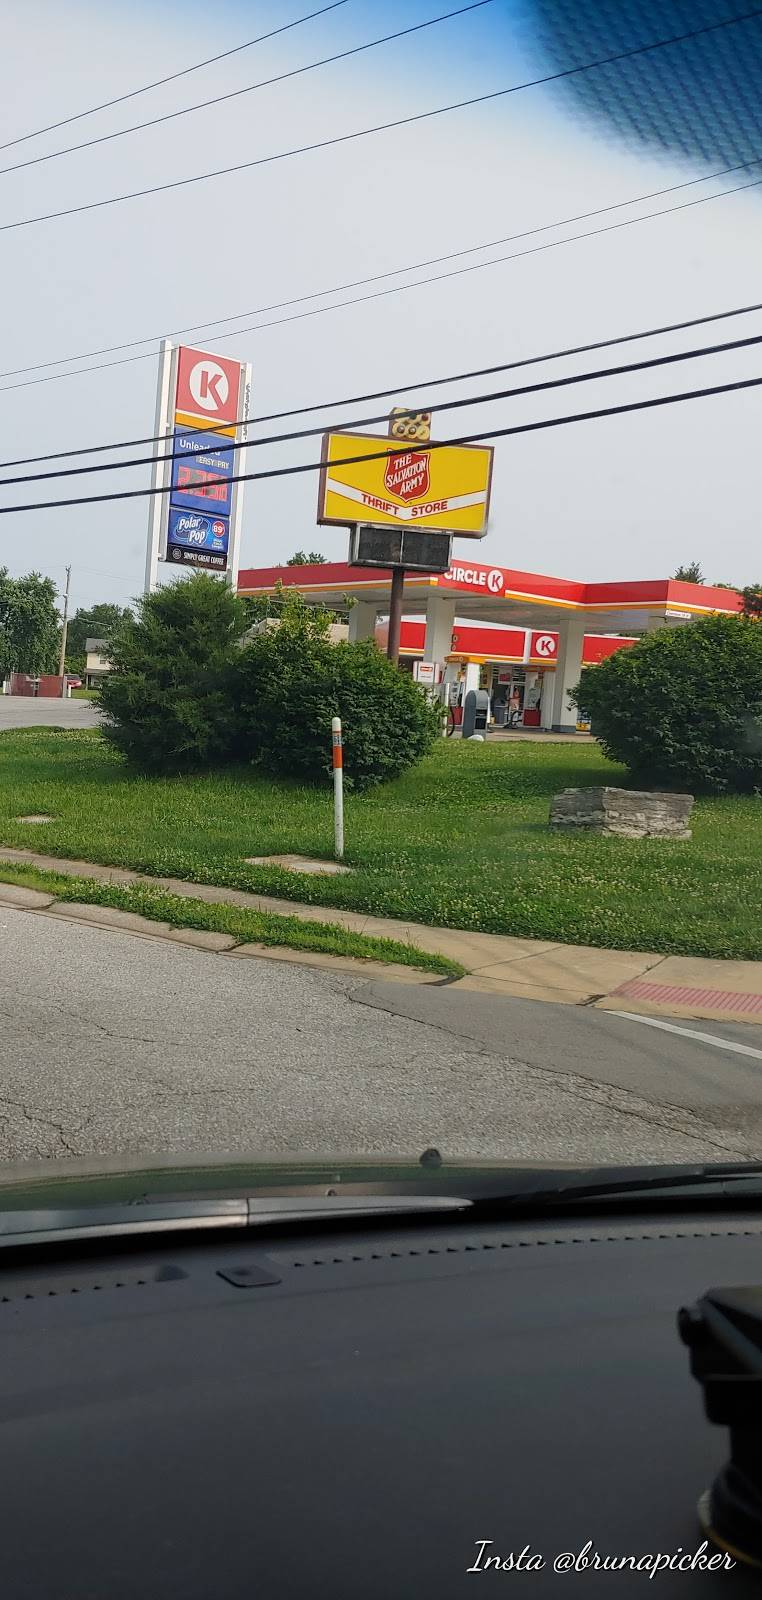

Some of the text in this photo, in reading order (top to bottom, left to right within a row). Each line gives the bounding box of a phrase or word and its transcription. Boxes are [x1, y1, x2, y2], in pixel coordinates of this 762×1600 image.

[394, 454, 412, 470] THE
[386, 457, 427, 488] SALVATION
[399, 473, 424, 496] ARMY
[361, 493, 448, 517] THRIFT STORE
[179, 517, 201, 530] Polar
[189, 530, 205, 543] Pop
[443, 567, 487, 586] CIRCLE
